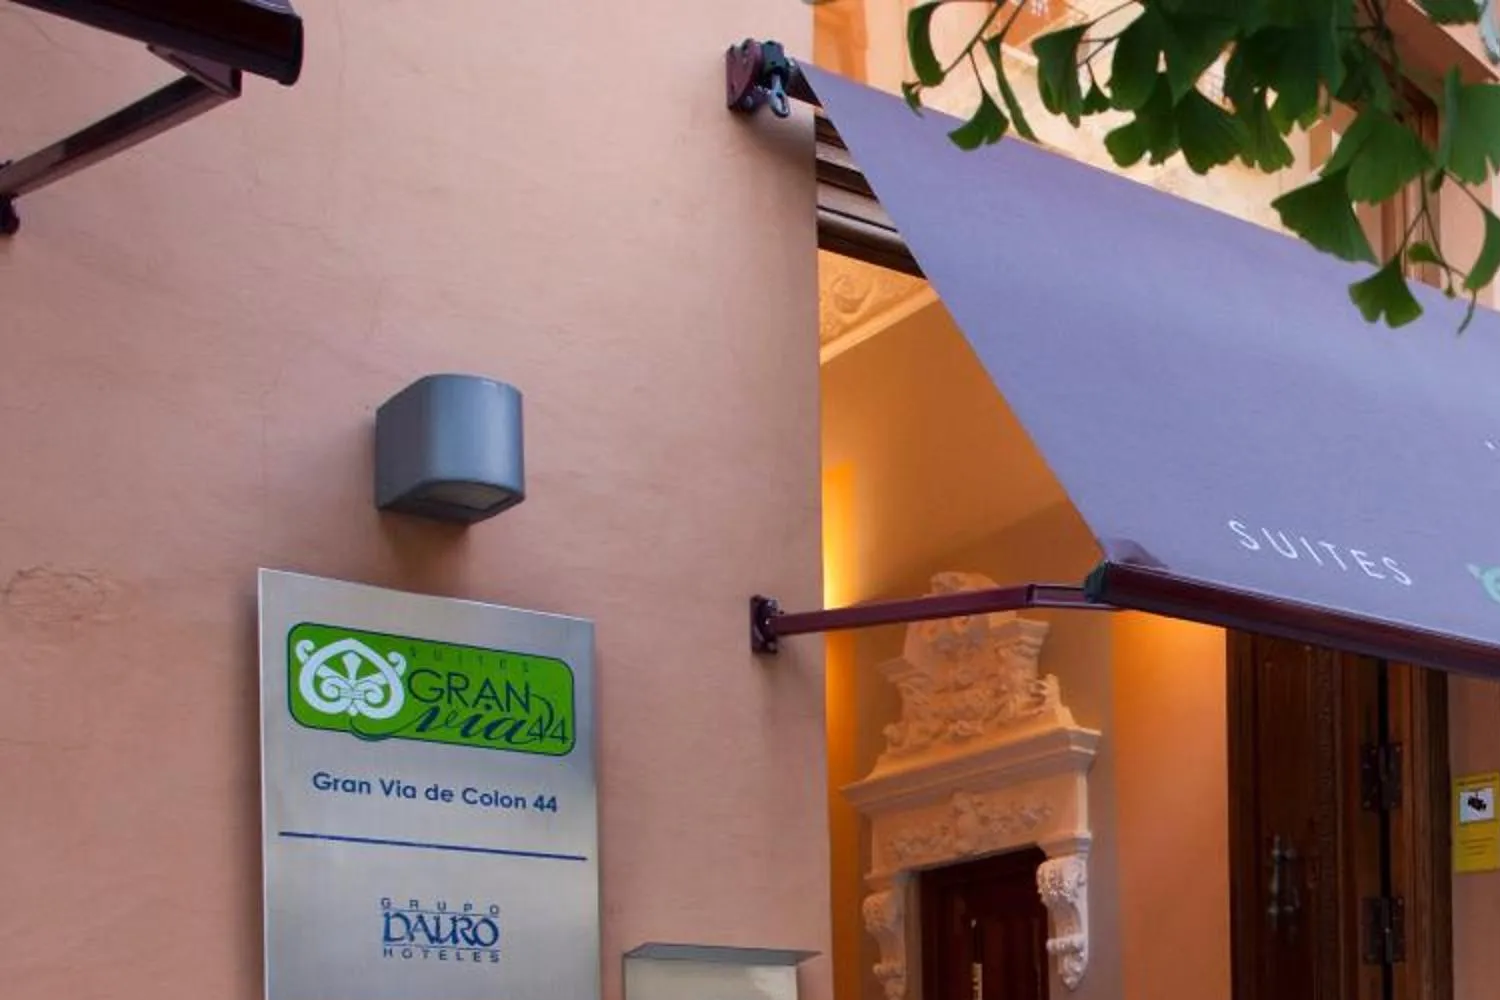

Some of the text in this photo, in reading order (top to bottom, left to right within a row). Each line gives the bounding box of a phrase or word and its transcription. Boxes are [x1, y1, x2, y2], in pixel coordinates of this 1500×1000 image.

[1229, 520, 1412, 586] SUITES
[407, 668, 531, 714] GRAN
[526, 714, 568, 745] 44
[312, 772, 558, 813] Gran Via de Colon 44
[380, 897, 500, 915] GRUPO
[383, 911, 499, 947] DAURO
[383, 948, 500, 963] HOTELES
